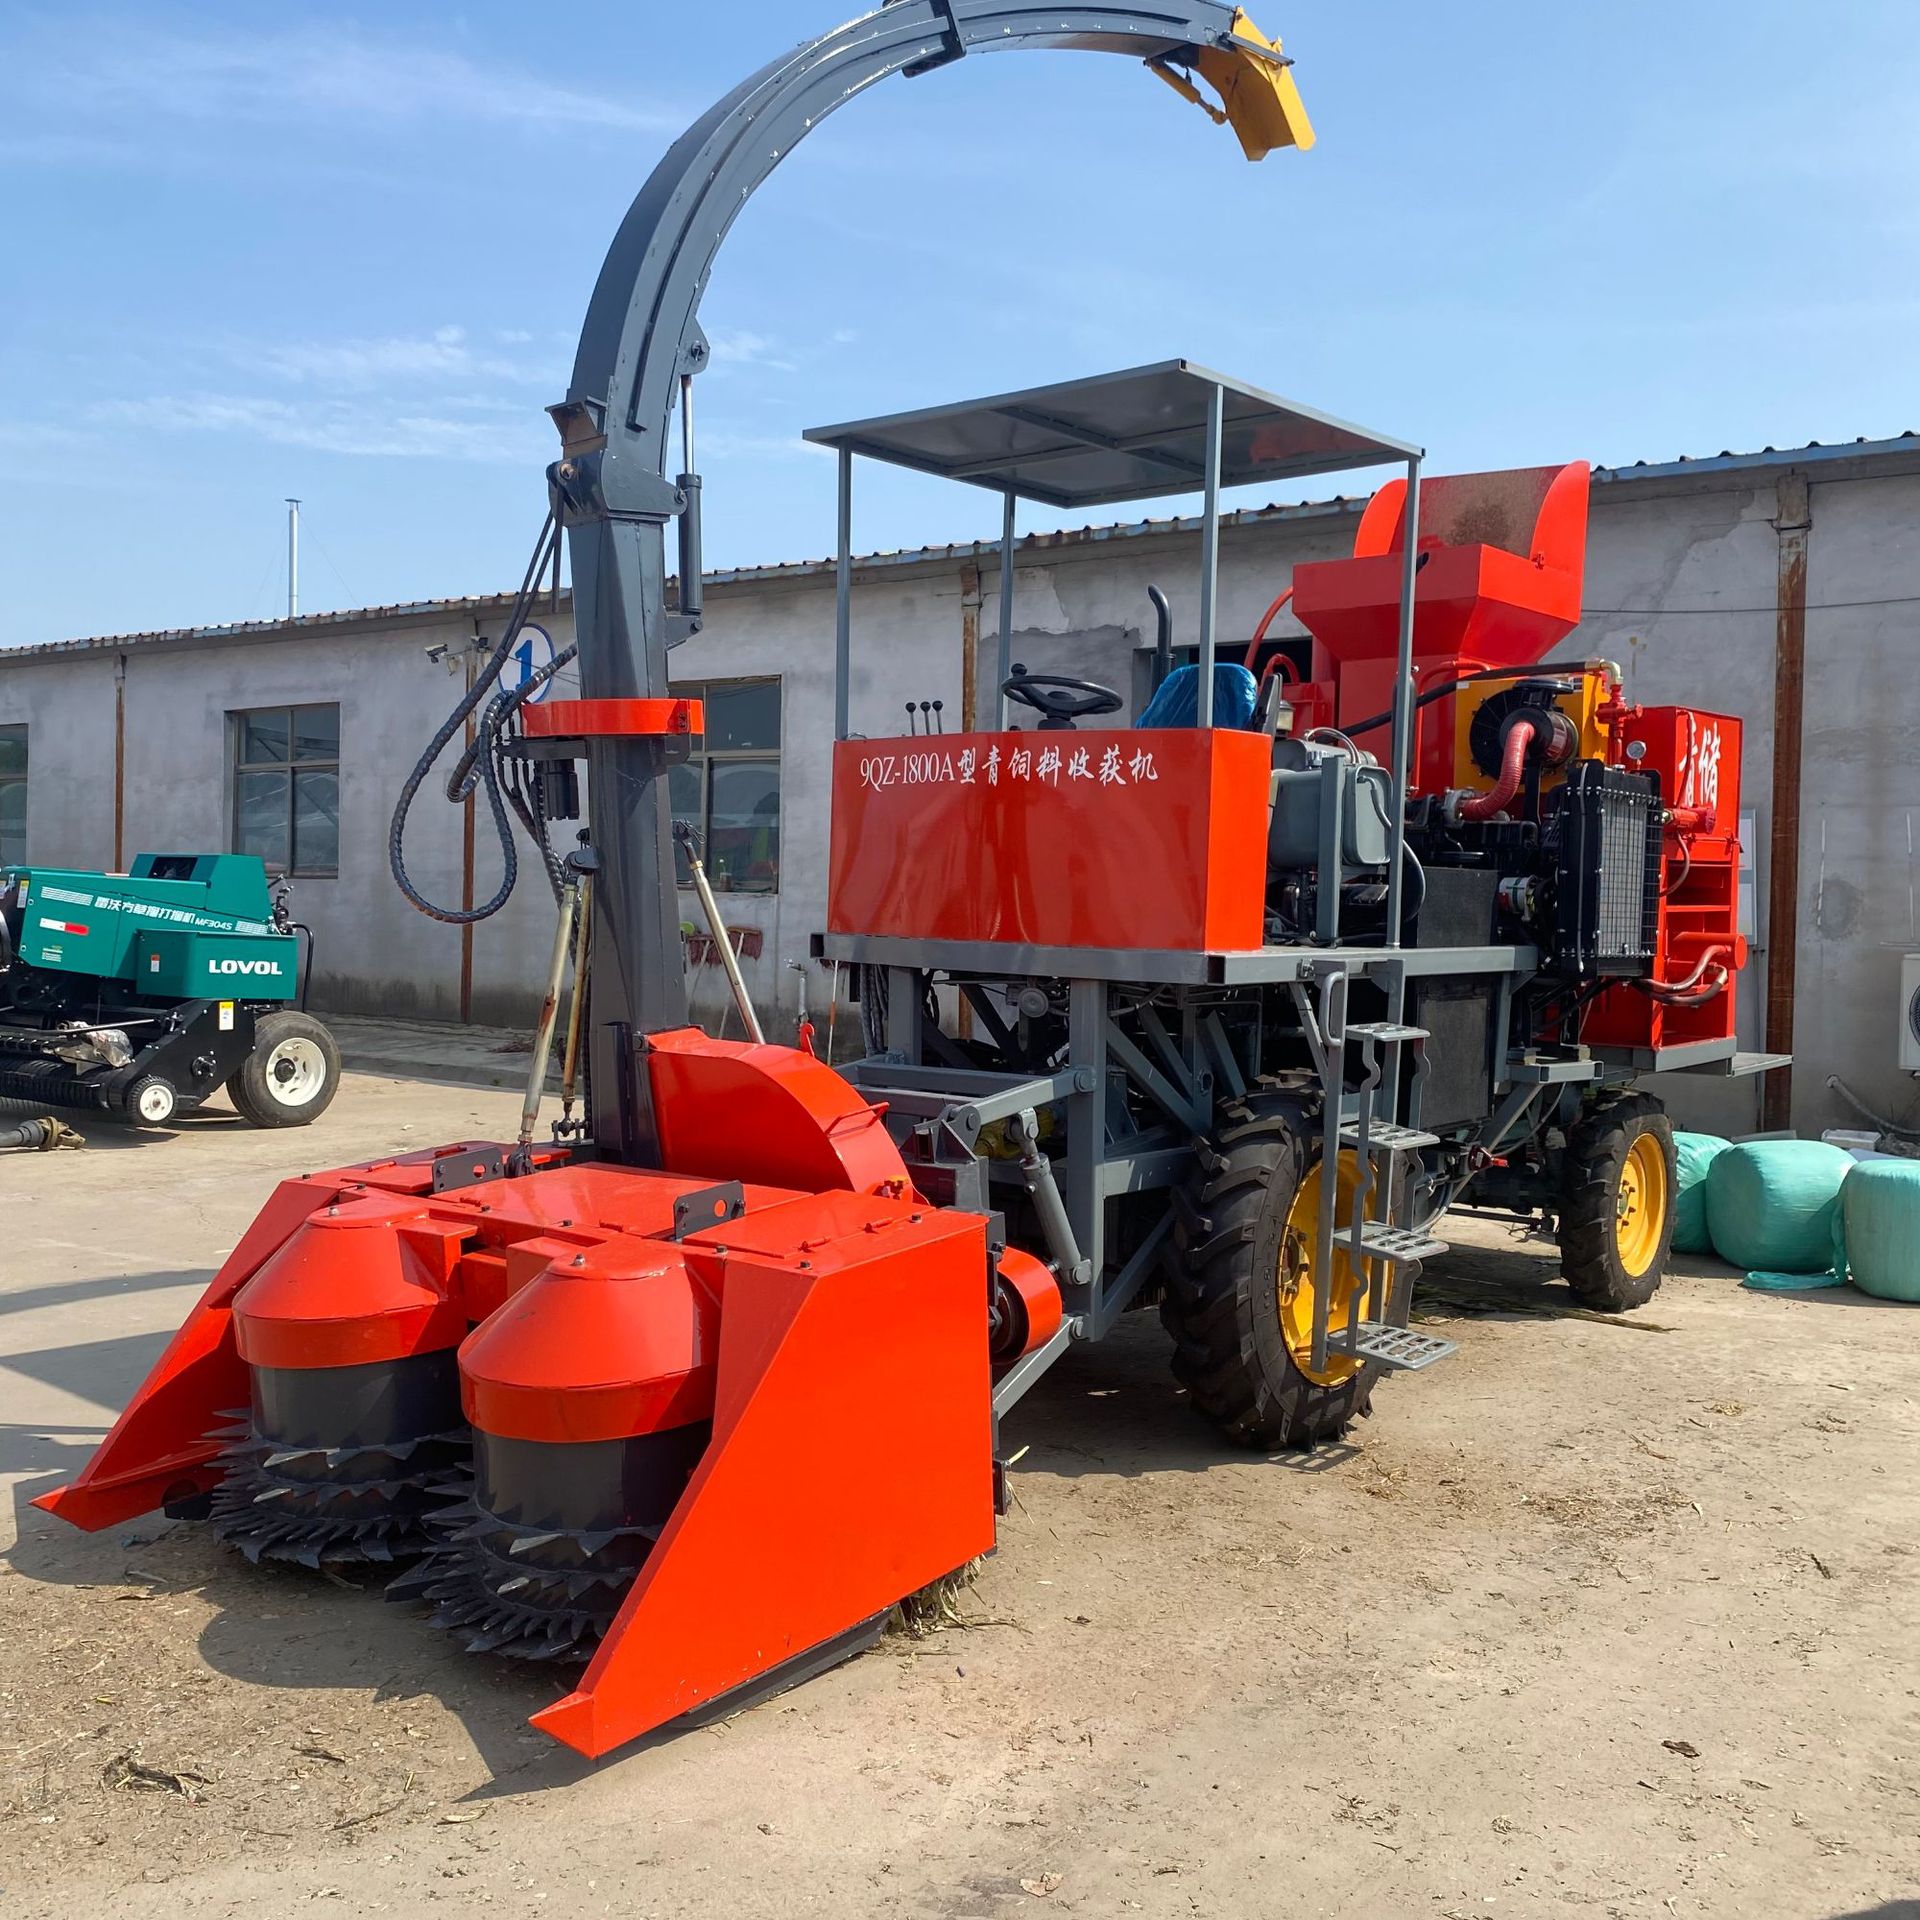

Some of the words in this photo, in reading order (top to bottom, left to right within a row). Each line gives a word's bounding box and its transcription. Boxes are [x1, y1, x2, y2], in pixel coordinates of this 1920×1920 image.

[515, 640, 533, 690] 1
[860, 743, 1158, 792] 9QZ-1800A型青饲料收获机
[209, 959, 283, 975] LOVOL
